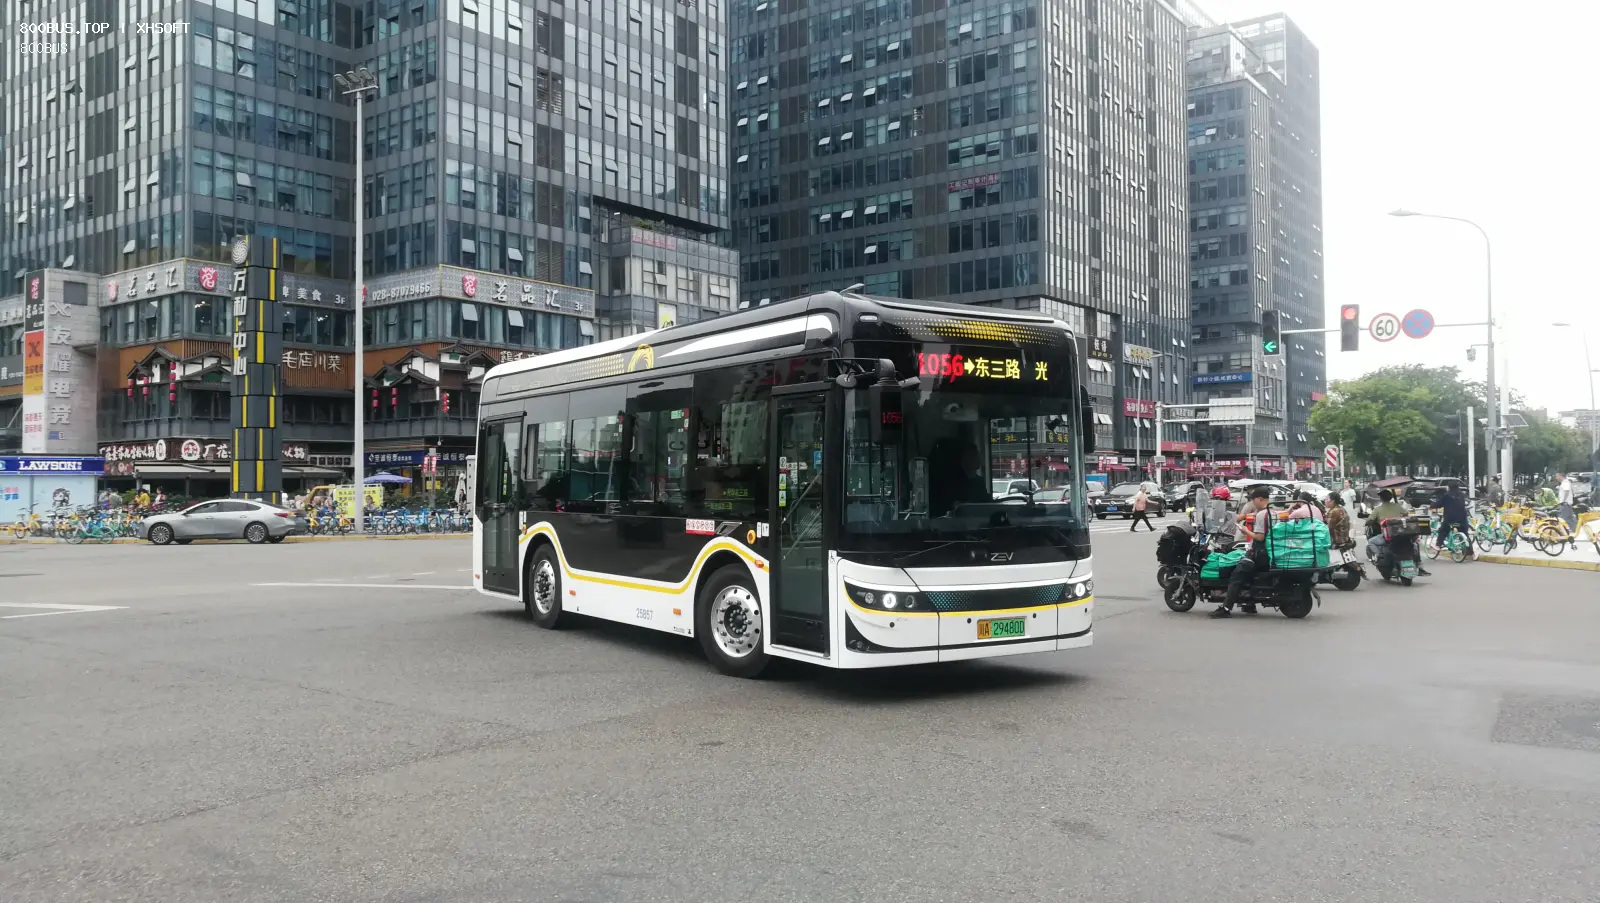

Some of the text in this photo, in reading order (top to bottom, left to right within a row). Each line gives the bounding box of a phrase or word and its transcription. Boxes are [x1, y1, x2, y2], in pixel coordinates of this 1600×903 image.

[372, 282, 430, 301] 028-87079466
[1375, 319, 1394, 336] 60
[282, 350, 341, 373] 毛店川菜
[918, 352, 1048, 380] 1056 东三路 光
[203, 443, 231, 459] 厂花
[19, 461, 77, 471] LAWSON
[636, 607, 653, 621] 25857
